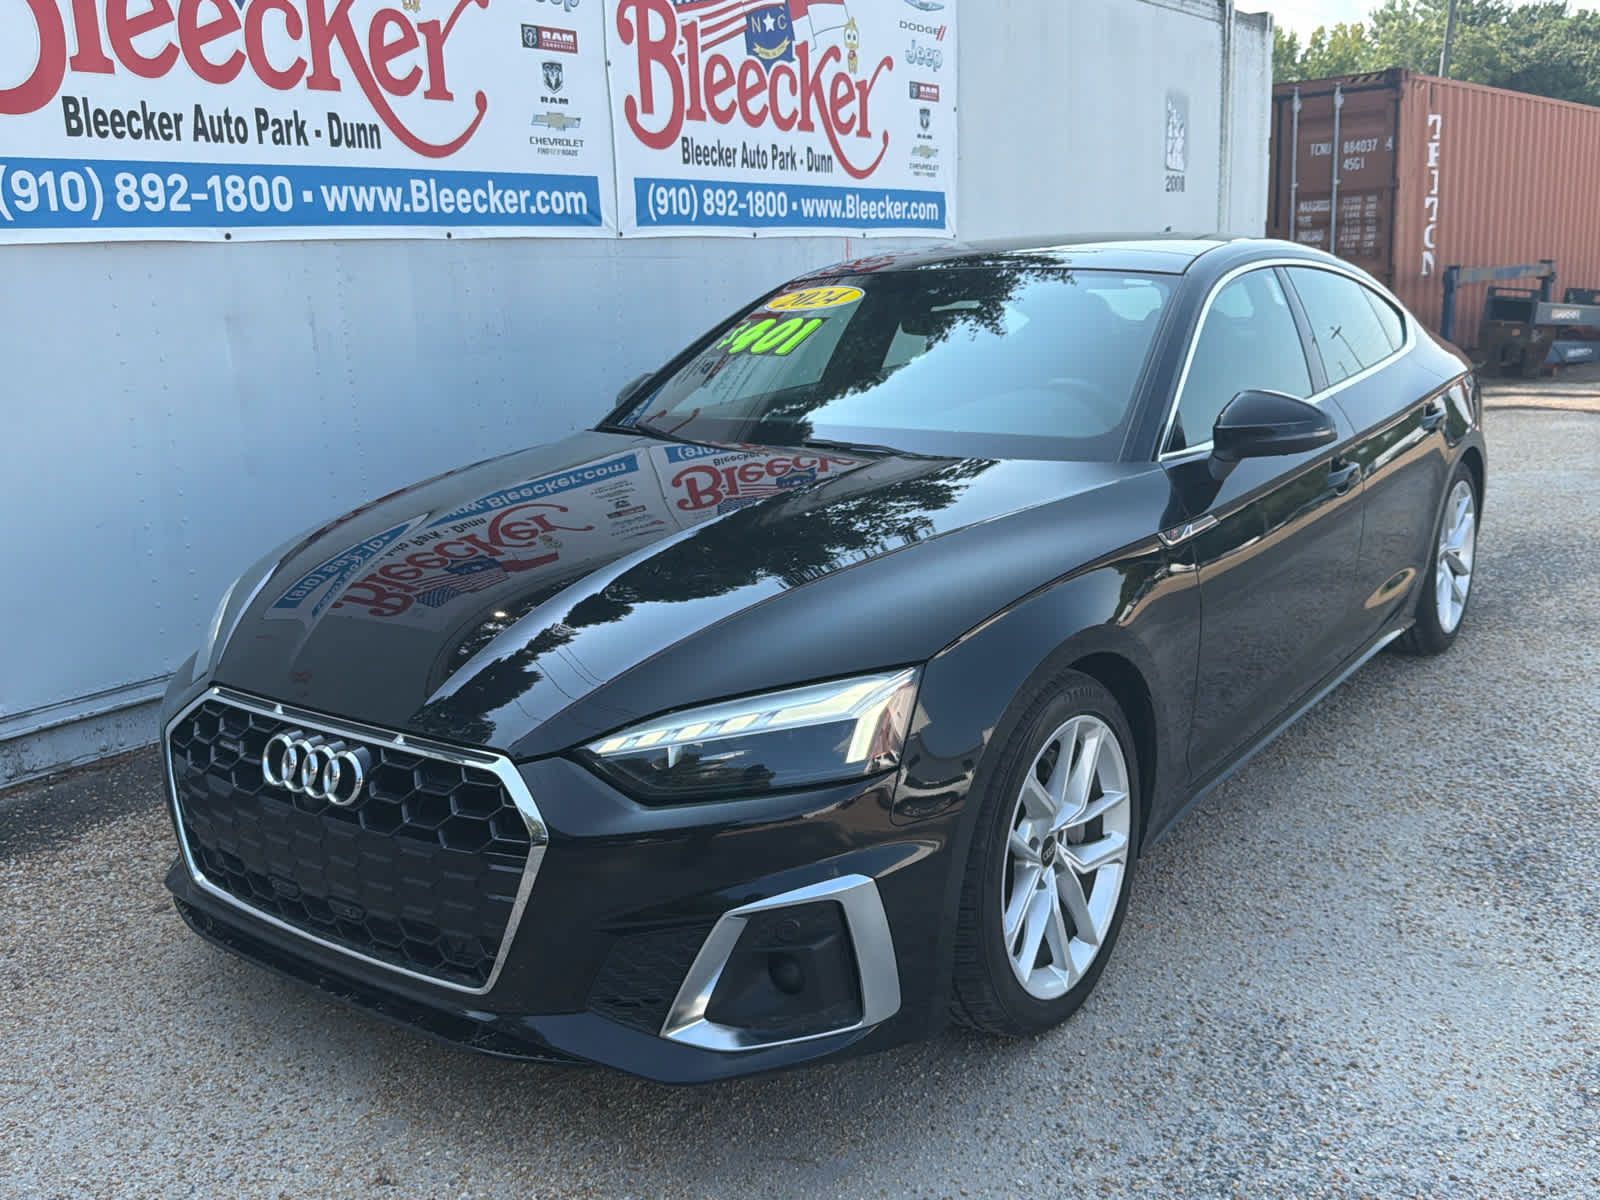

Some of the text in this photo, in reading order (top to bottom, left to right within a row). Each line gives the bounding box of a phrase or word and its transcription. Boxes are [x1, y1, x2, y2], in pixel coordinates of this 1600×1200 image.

[541, 30, 575, 43] RAM
[899, 20, 939, 36] DODGE
[905, 40, 943, 72] Jeep
[0, 0, 488, 158] leecker
[540, 96, 569, 105] RAM
[62, 95, 183, 142] Bleecker
[193, 104, 248, 145] Auto
[255, 107, 309, 147] Park
[328, 112, 382, 149] Dunn
[529, 136, 584, 147] CHEVROLET
[681, 137, 737, 168] Bleecker
[741, 140, 768, 170] Auto
[771, 144, 797, 171] Park
[807, 147, 833, 174] Dunn
[0, 165, 588, 221] (910) 892-1800 www.Bleecker.com
[648, 184, 939, 221] (910) 892-1800 www.Bleecker.com
[775, 290, 854, 308] 2024
